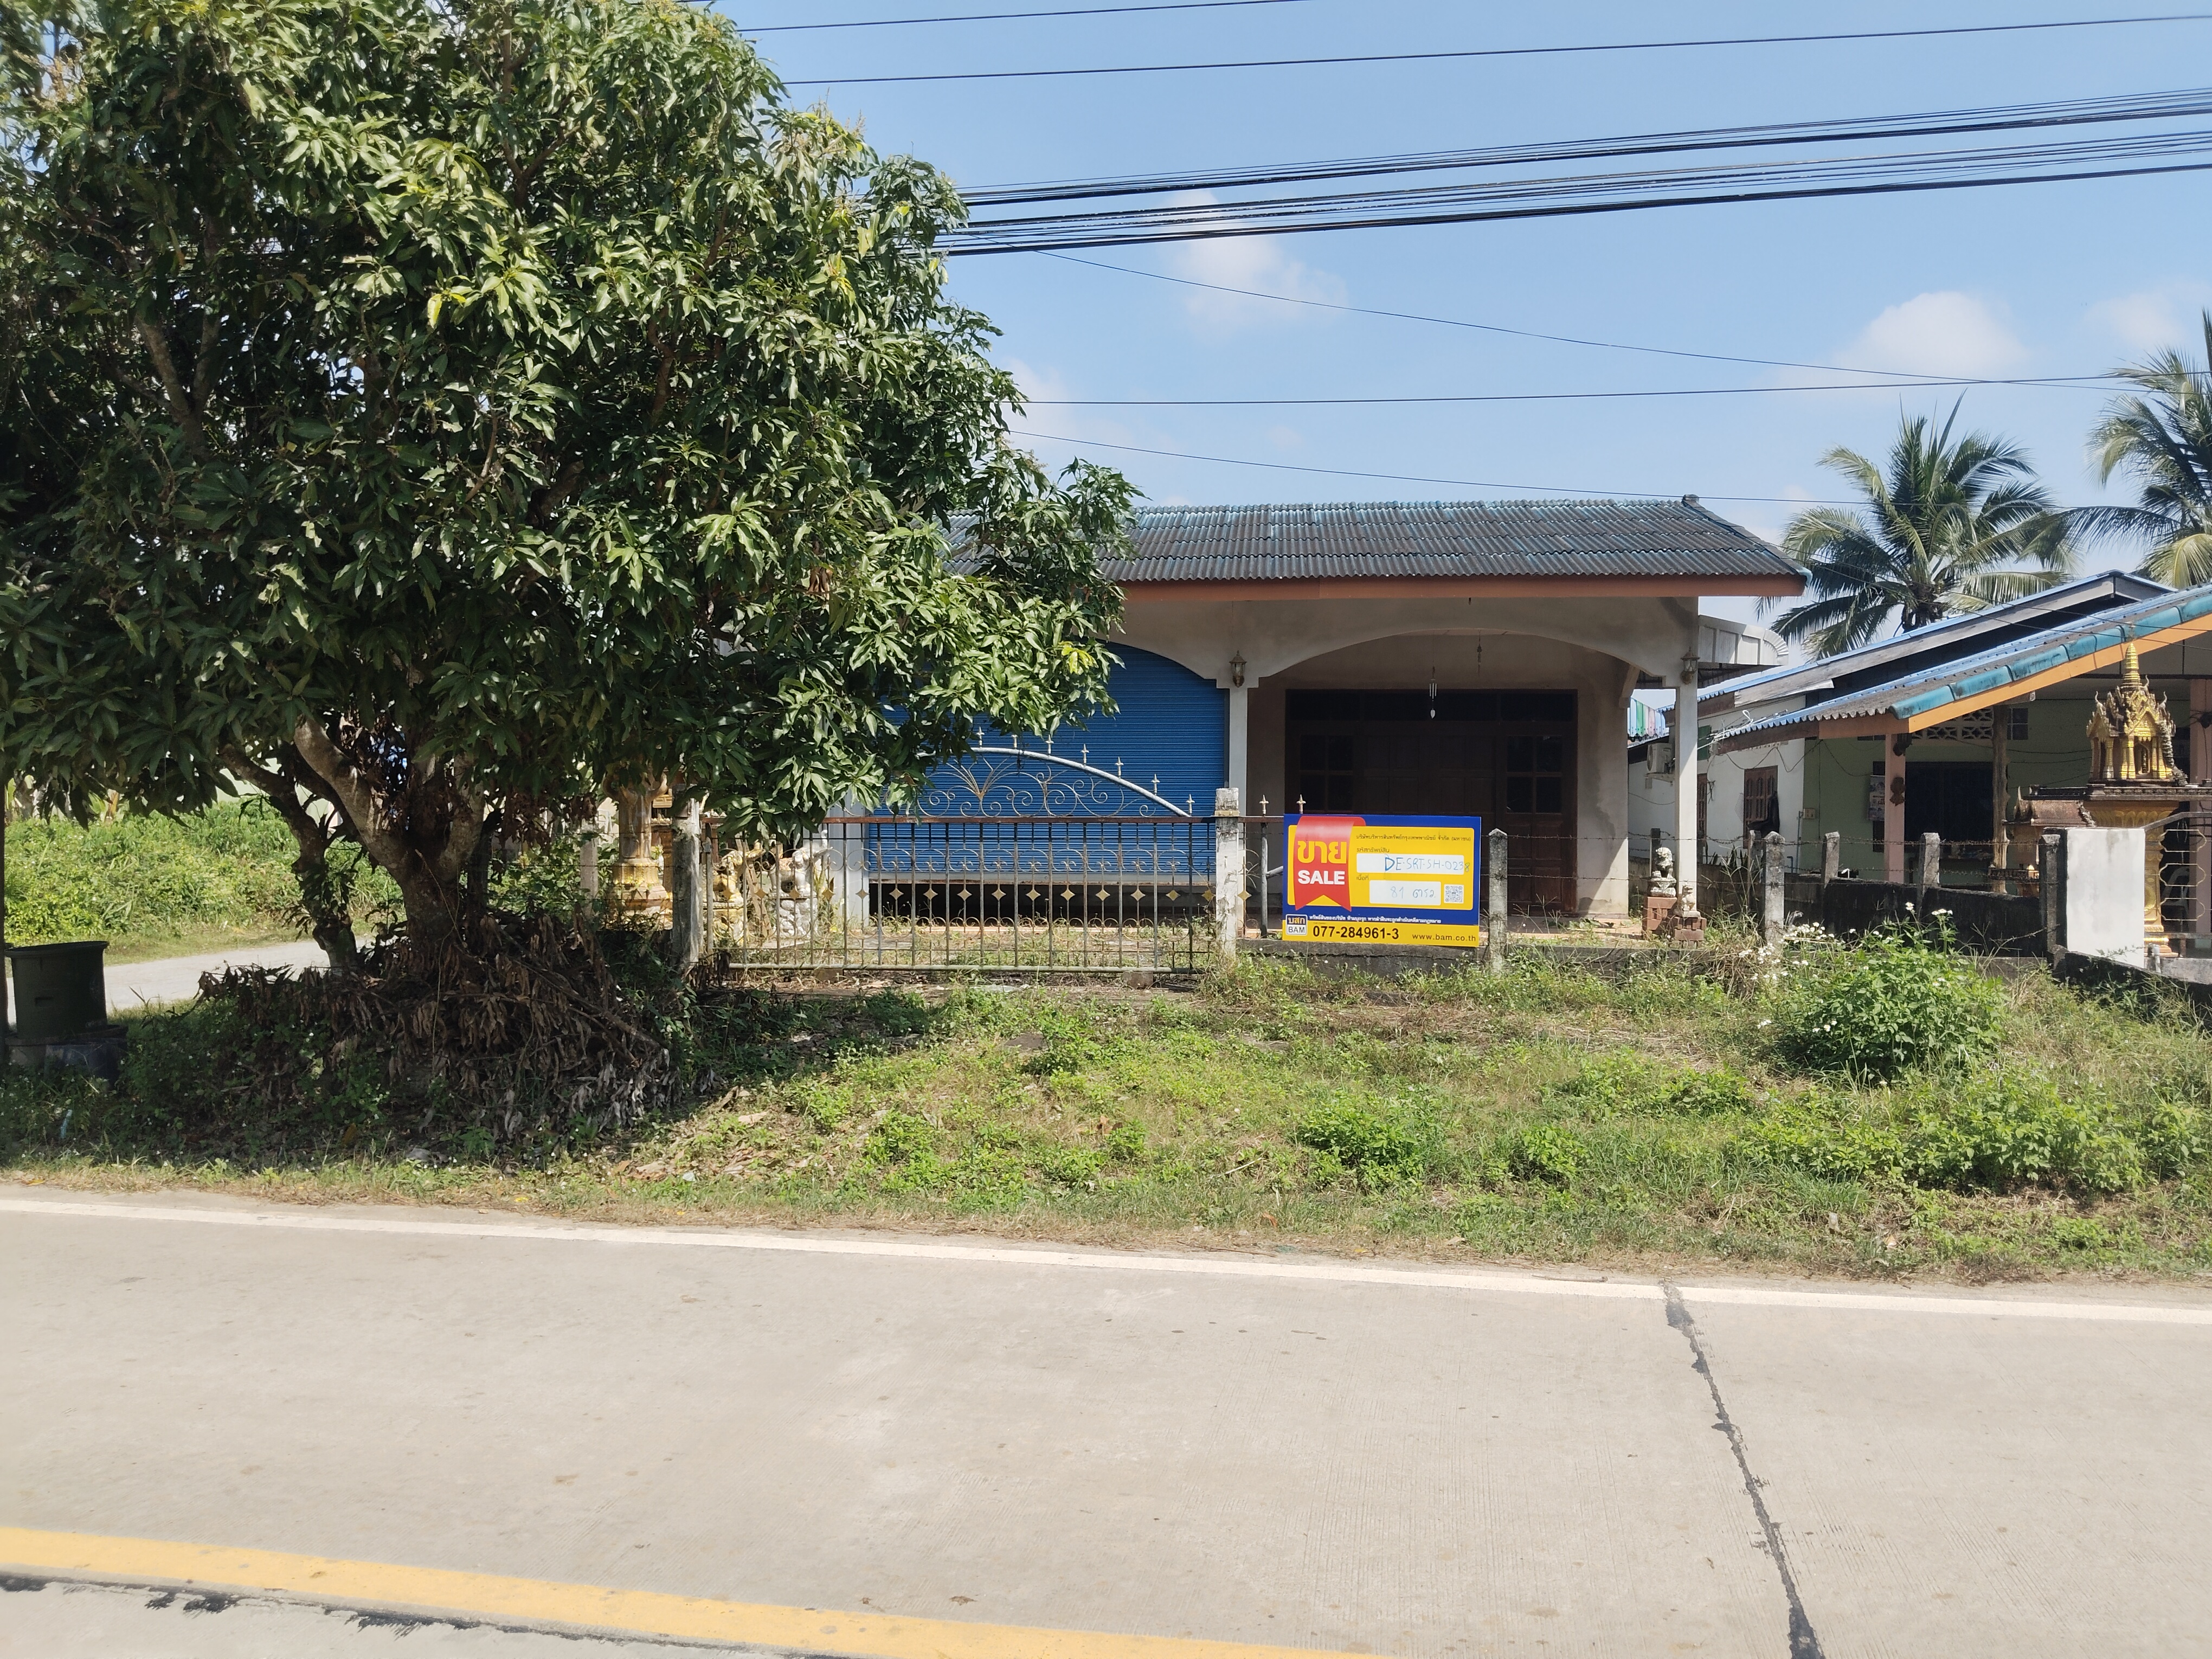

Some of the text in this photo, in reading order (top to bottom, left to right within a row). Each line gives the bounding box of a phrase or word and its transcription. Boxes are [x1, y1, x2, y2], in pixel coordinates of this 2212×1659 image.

[1297, 840, 1347, 864] ขาย
[1298, 870, 1345, 885] SALE
[1390, 886, 1404, 899] 81
[1313, 926, 1399, 939] 077-284961-3
